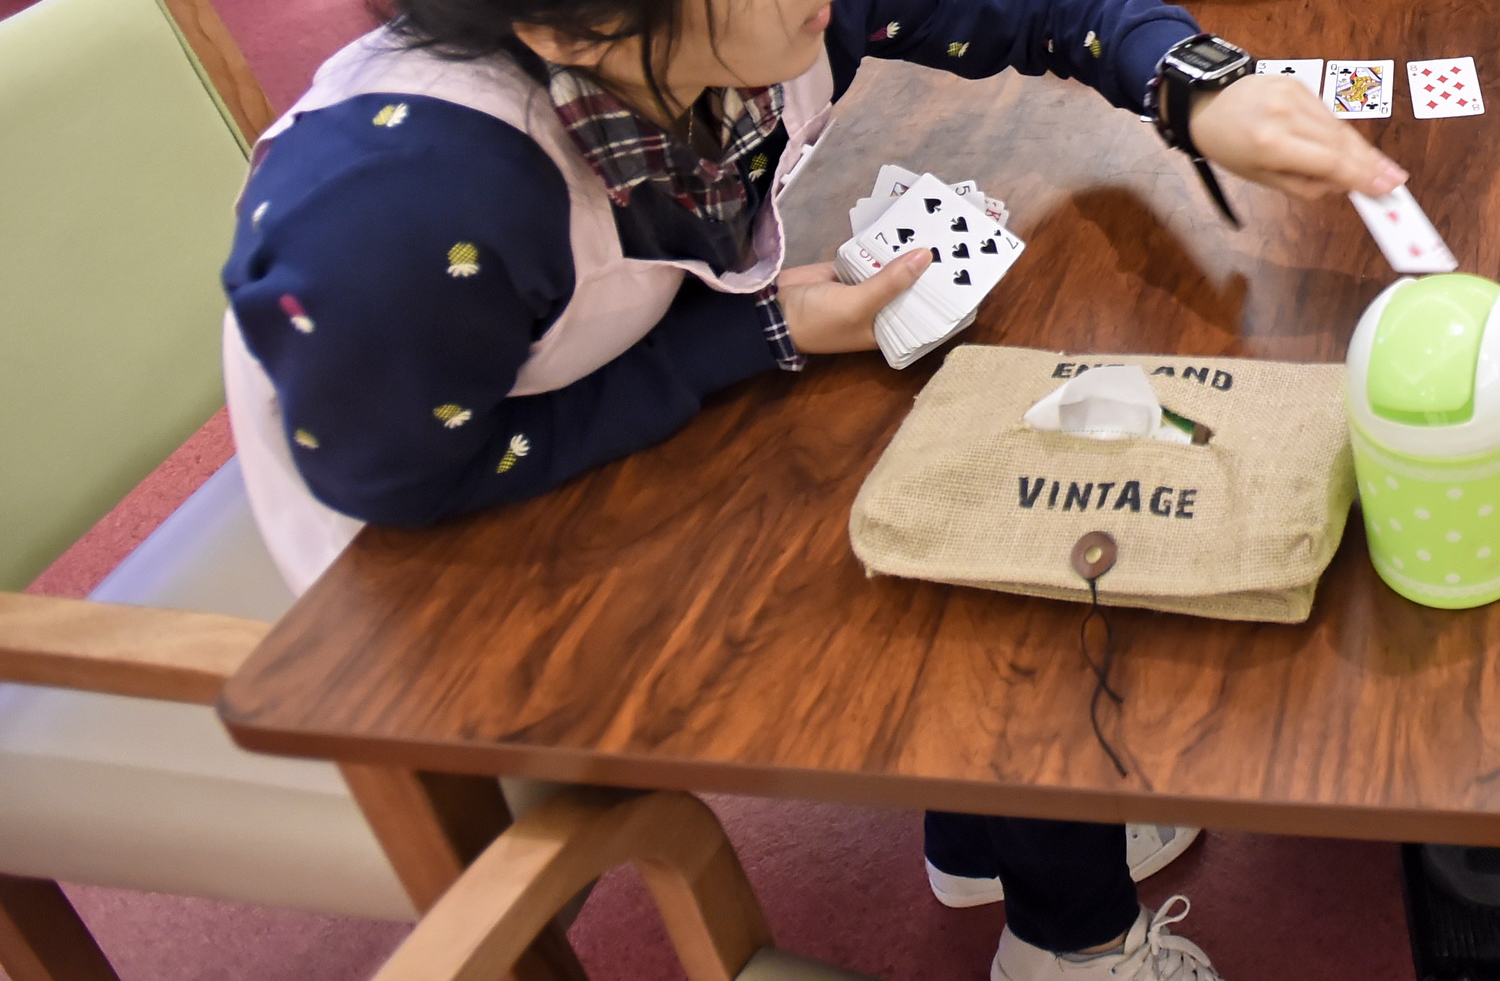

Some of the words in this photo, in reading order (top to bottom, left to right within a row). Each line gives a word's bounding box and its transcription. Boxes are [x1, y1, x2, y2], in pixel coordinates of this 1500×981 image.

[1330, 63, 1338, 71] Q
[1409, 64, 1418, 72] 8
[1381, 106, 1388, 115] Q
[1472, 103, 1480, 111] 8
[955, 185, 971, 197] 5
[985, 208, 1002, 223] K
[874, 231, 889, 245] 7
[1005, 236, 1019, 250] 7
[1018, 476, 1198, 519] VINTAGE
